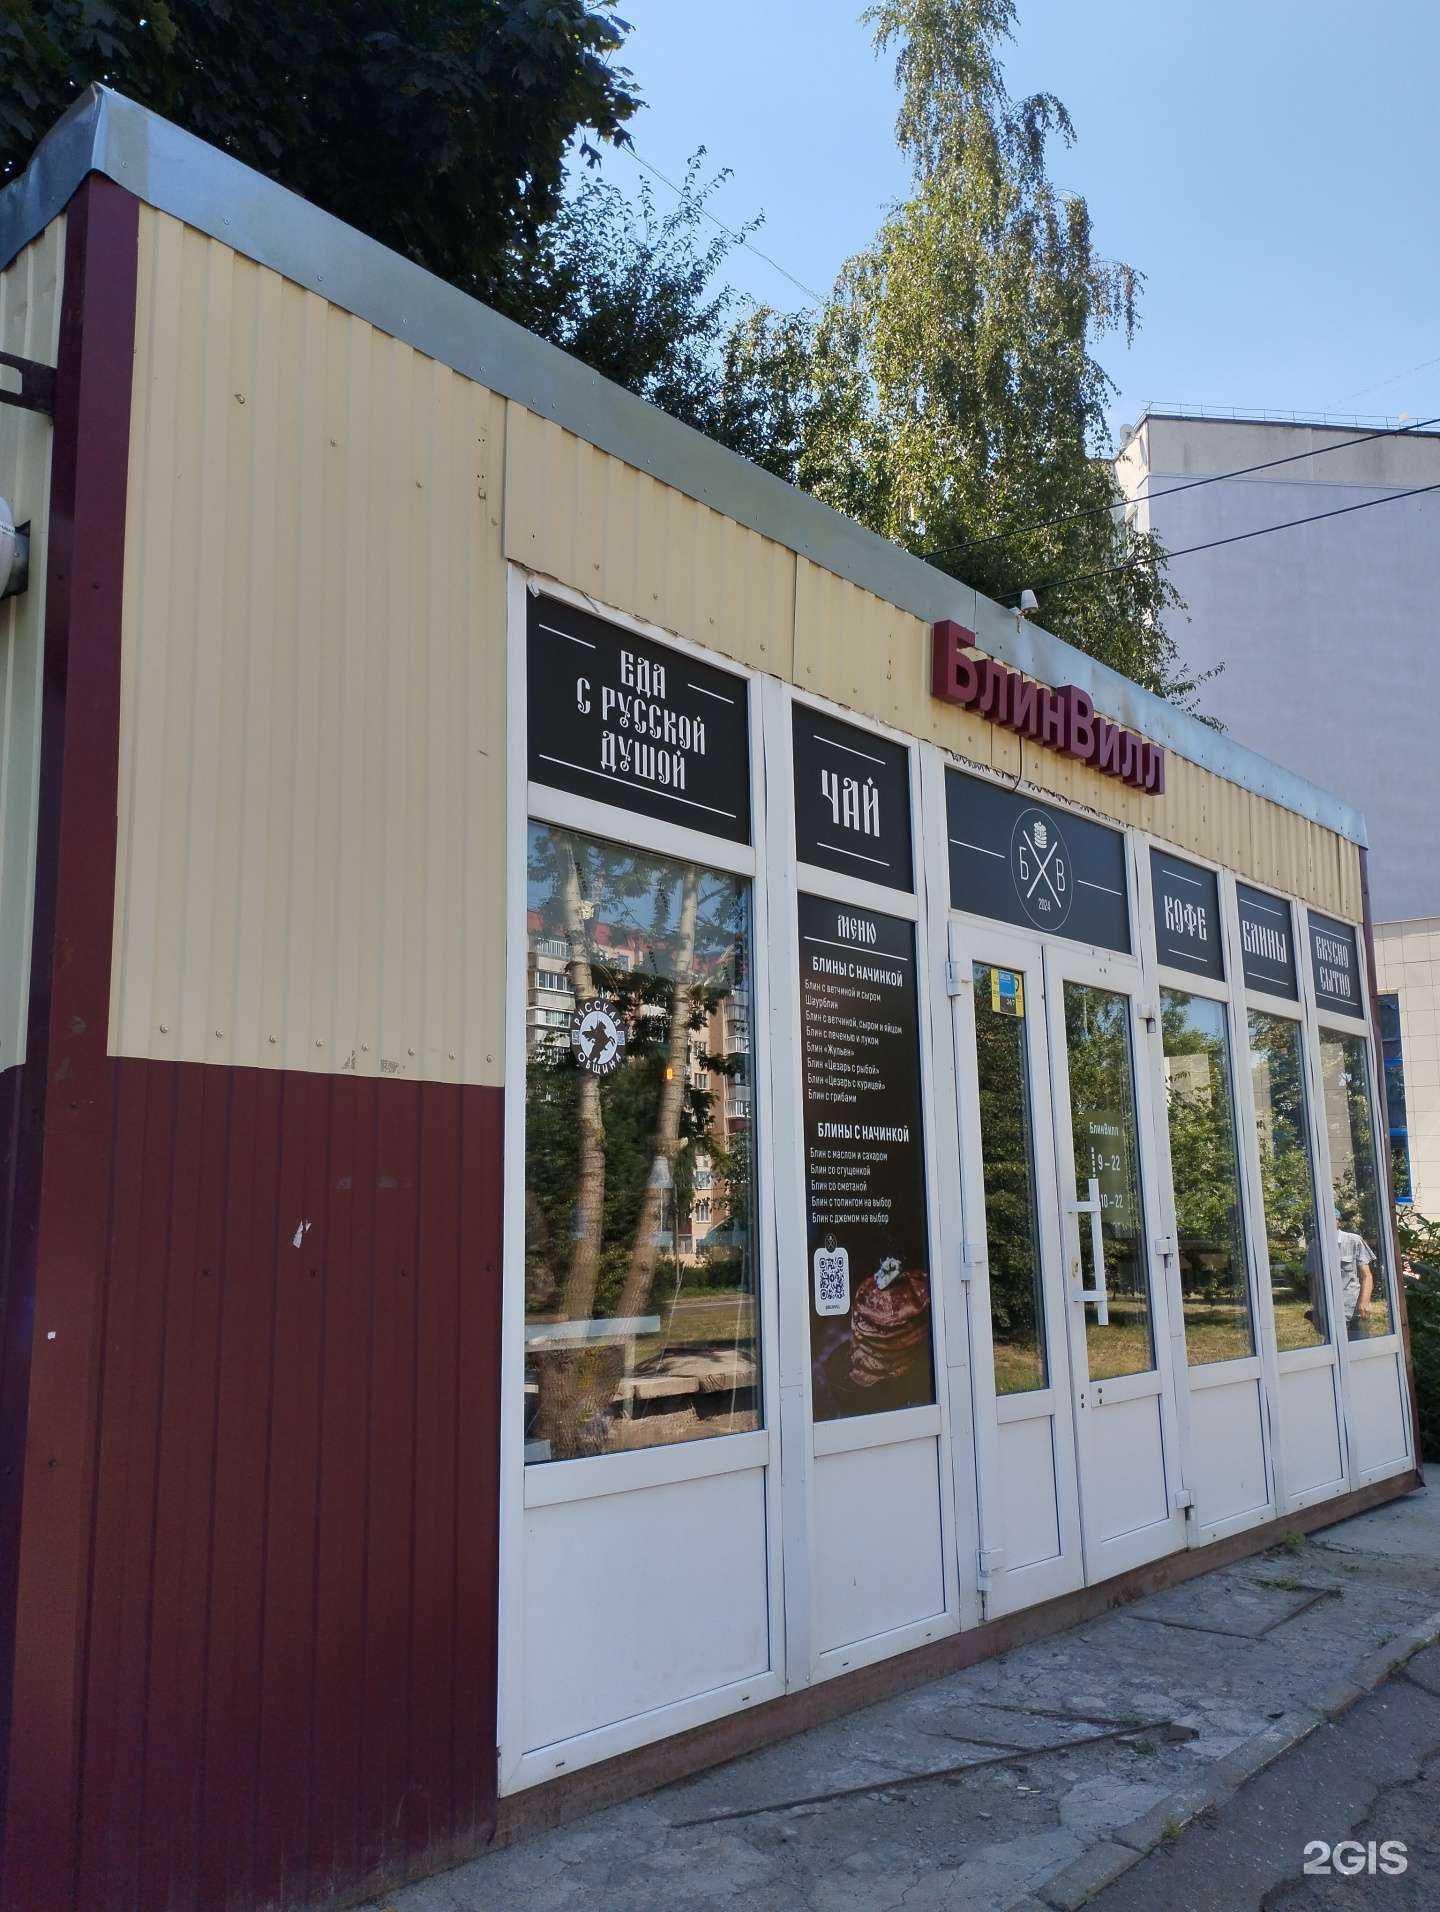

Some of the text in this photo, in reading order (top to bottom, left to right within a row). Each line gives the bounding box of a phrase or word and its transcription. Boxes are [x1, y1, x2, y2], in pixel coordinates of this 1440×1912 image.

[621, 650, 666, 699] ЕДА
[576, 677, 706, 756] С РУССКОЙ
[933, 619, 1165, 796] БлинВилл
[601, 730, 686, 790] ДУШОЙ
[821, 769, 880, 837] ЧАЙ
[1019, 846, 1065, 891] Б В
[1038, 897, 1051, 912] 2024
[1164, 895, 1207, 941] КОФЕ
[837, 914, 877, 944] МЕНЮ
[1242, 920, 1287, 964] БЛИНЫ
[1315, 935, 1349, 968] ВКУСНО
[812, 956, 903, 987] БЛИНЫ С НАЧИНКОЙ
[804, 979, 821, 991] Блин
[821, 984, 826, 992] с
[826, 985, 856, 998] ветчиной
[1319, 966, 1351, 998] СЫТНО
[805, 994, 839, 1010] Шаурблин
[805, 1010, 822, 1022] Блин
[822, 1014, 827, 1023] с
[859, 1020, 879, 1031] сыром
[806, 1025, 822, 1038] Блин
[823, 1030, 827, 1039] с
[806, 1041, 823, 1053] Блин
[807, 1057, 824, 1069] Блин
[807, 1073, 824, 1084] Блин
[808, 1088, 857, 1103] Блин с грибами
[817, 1122, 909, 1142] БЛИНЫ С НАЧИНКОЙ
[810, 1147, 826, 1159] Блин
[827, 1150, 832, 1159] с
[810, 1163, 826, 1175] Блин
[827, 1165, 836, 1175] со
[811, 1180, 828, 1190] Блин
[828, 1182, 837, 1191] со
[811, 1196, 828, 1207] Блин
[829, 1198, 833, 1207] с
[812, 1212, 829, 1223] Блин
[829, 1214, 833, 1223] с
